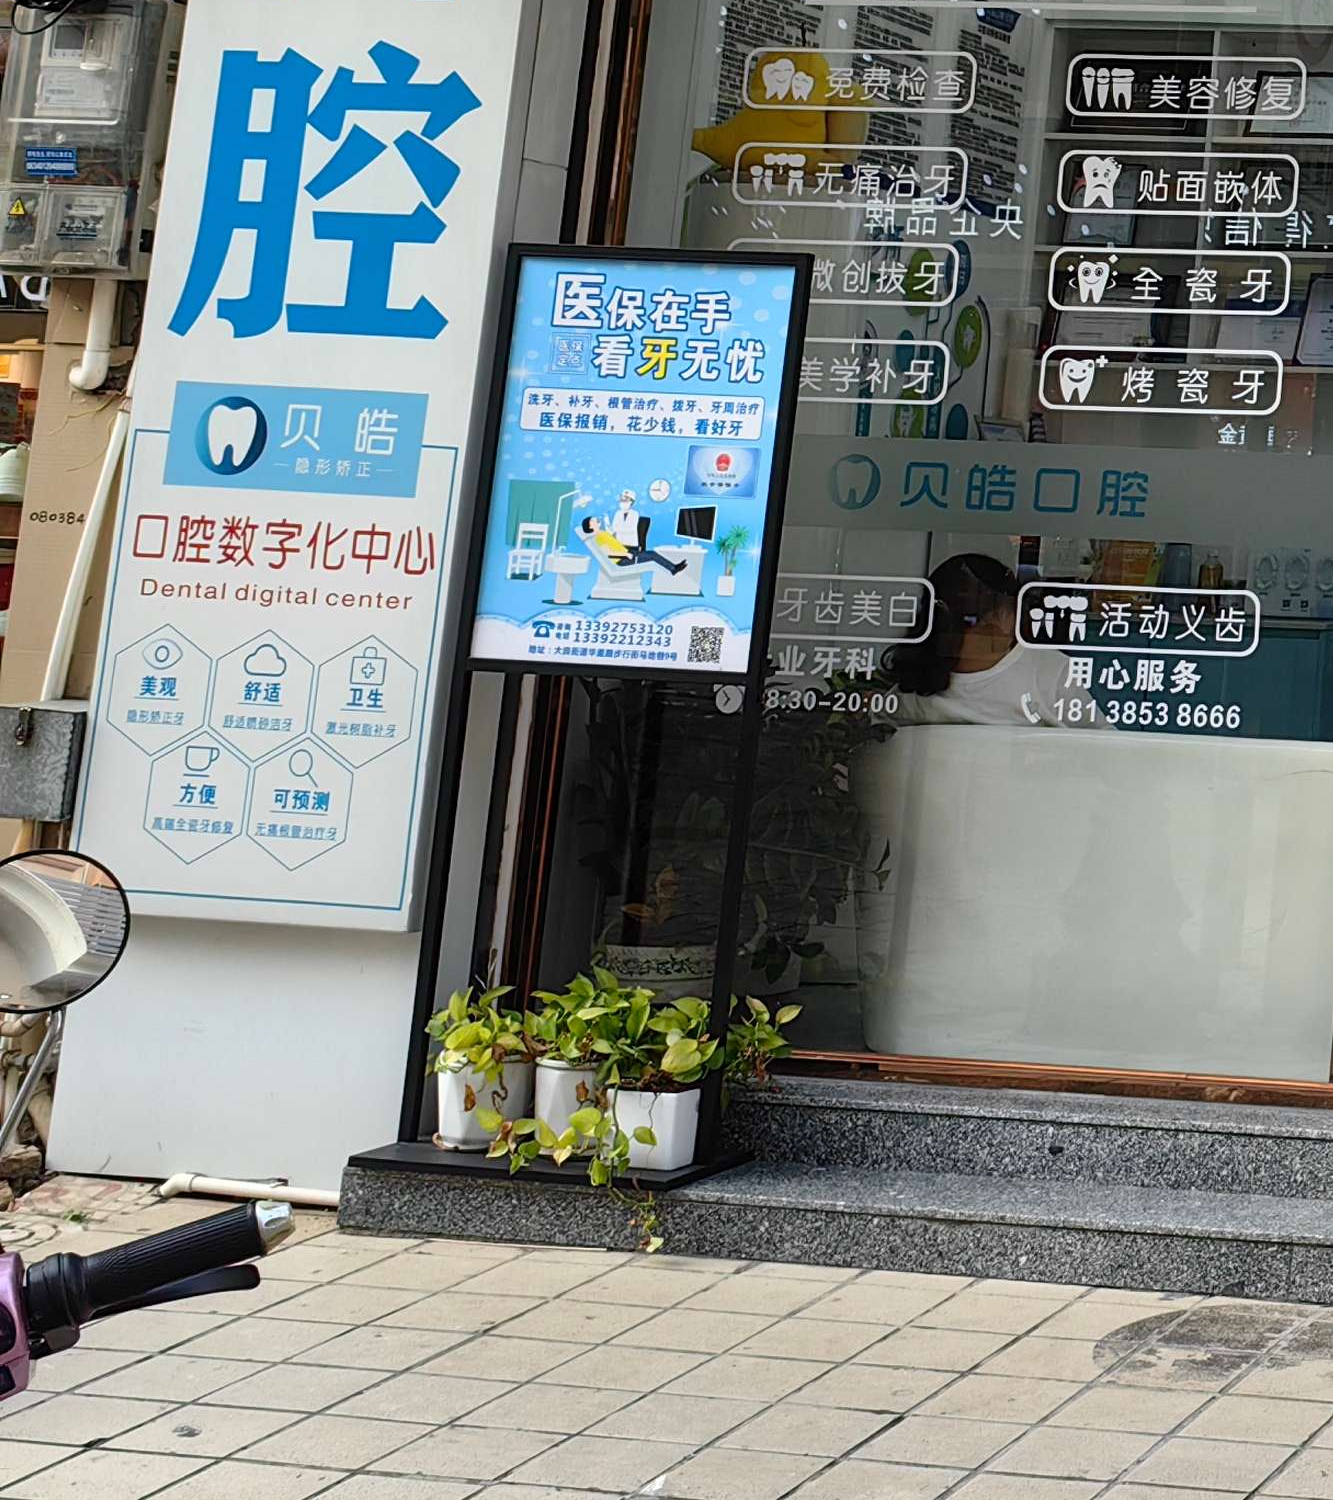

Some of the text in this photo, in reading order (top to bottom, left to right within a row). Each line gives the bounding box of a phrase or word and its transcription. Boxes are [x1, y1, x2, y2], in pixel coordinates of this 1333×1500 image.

[825, 67, 966, 101] 免费检查
[1148, 74, 1296, 112] 美容修复
[811, 163, 957, 201] 无痛治牙
[1137, 167, 1282, 206] 贴面嵌体
[812, 259, 945, 295] 微创拔牙
[1131, 266, 1272, 304] 全瓷牙
[552, 272, 732, 334] 医保在手
[592, 335, 766, 383] 看牙无忧
[799, 356, 935, 394] 美学补牙
[1121, 365, 1266, 406] 烤瓷牙
[279, 404, 400, 456] 贝皓
[294, 457, 372, 478] 隐形矫正
[900, 462, 1150, 519] 贝皓口腔
[132, 514, 436, 576] 口腔数字化中心
[140, 578, 413, 610] Dental digital center
[776, 581, 917, 627] 牙齿美白
[574, 632, 672, 647] 13392212343
[576, 620, 674, 636] 13392753120
[1099, 601, 1247, 642] 活动义齿
[767, 645, 876, 680] 业牙科
[1064, 657, 1202, 695] 用心服务
[140, 676, 178, 697] 美观
[243, 682, 282, 703] 舒适
[347, 688, 385, 709] 卫生
[1054, 698, 1241, 729] 181 3853 8666
[179, 782, 217, 805] 方便
[273, 787, 331, 812] 可预测
